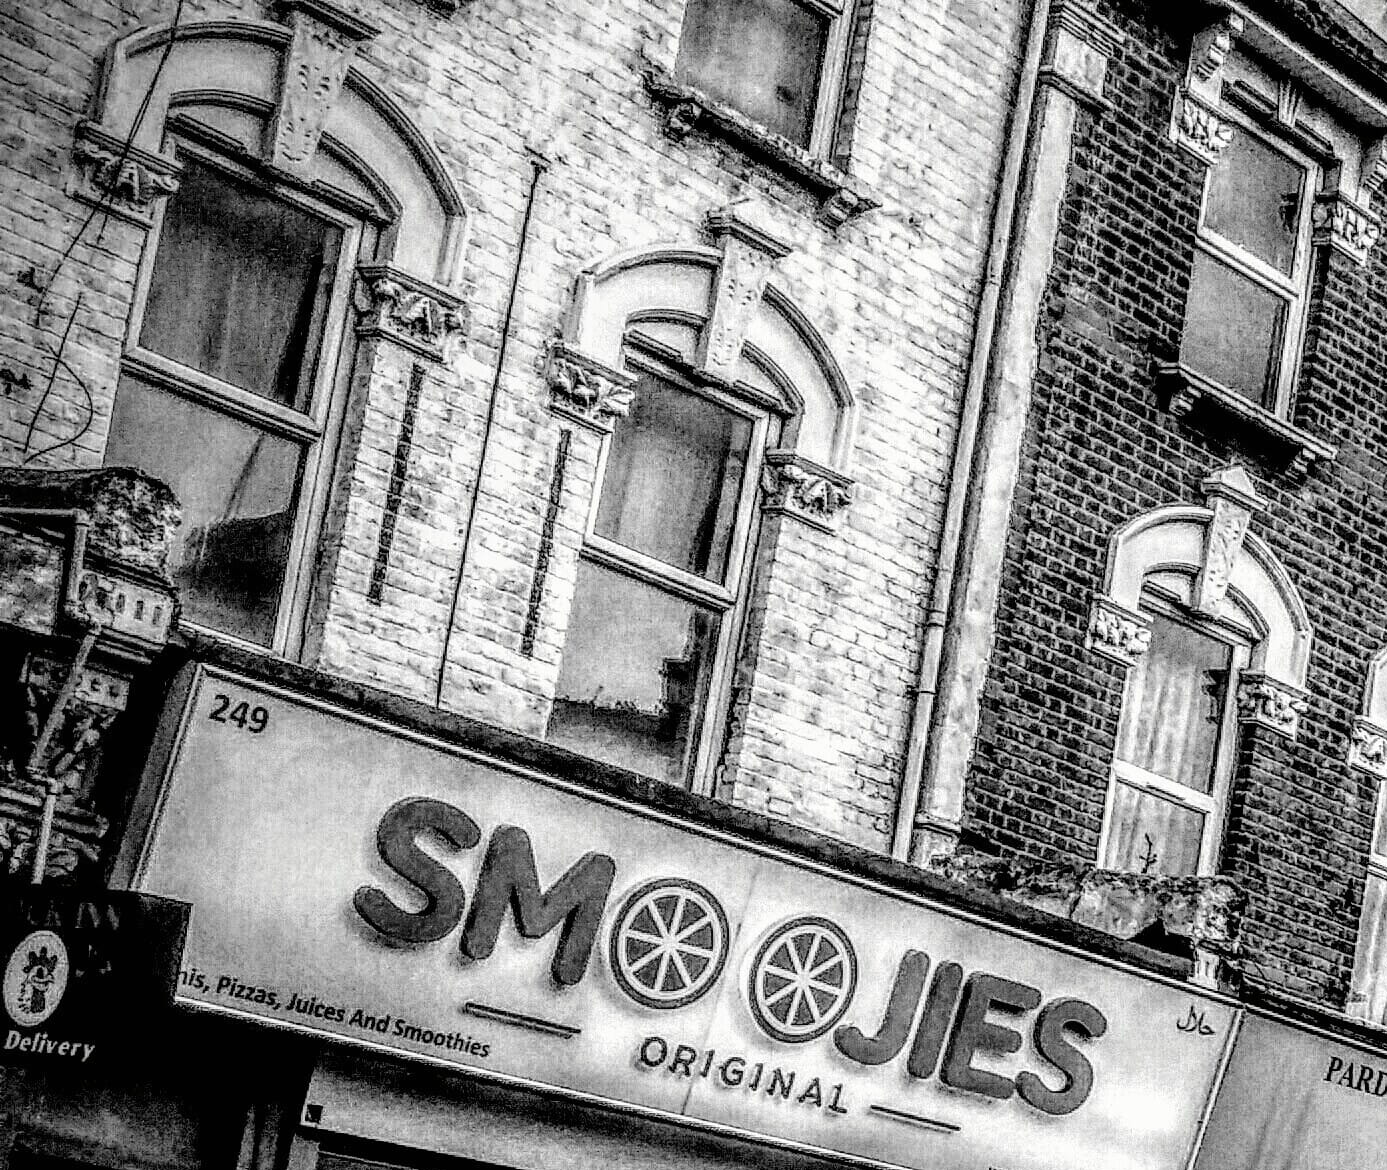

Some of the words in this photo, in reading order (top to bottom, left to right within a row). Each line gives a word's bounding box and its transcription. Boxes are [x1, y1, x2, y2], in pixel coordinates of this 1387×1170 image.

[209, 694, 269, 734] 249
[352, 796, 1108, 1116] SMOOJIES
[3, 1030, 96, 1062] Delivery
[217, 976, 281, 1010] Pizzas,
[286, 993, 346, 1023] Juices
[349, 1008, 391, 1034] And
[393, 1018, 491, 1058] Smoothies
[1176, 1005, 1216, 1036] حلال
[640, 1036, 848, 1115] ORIGINAL
